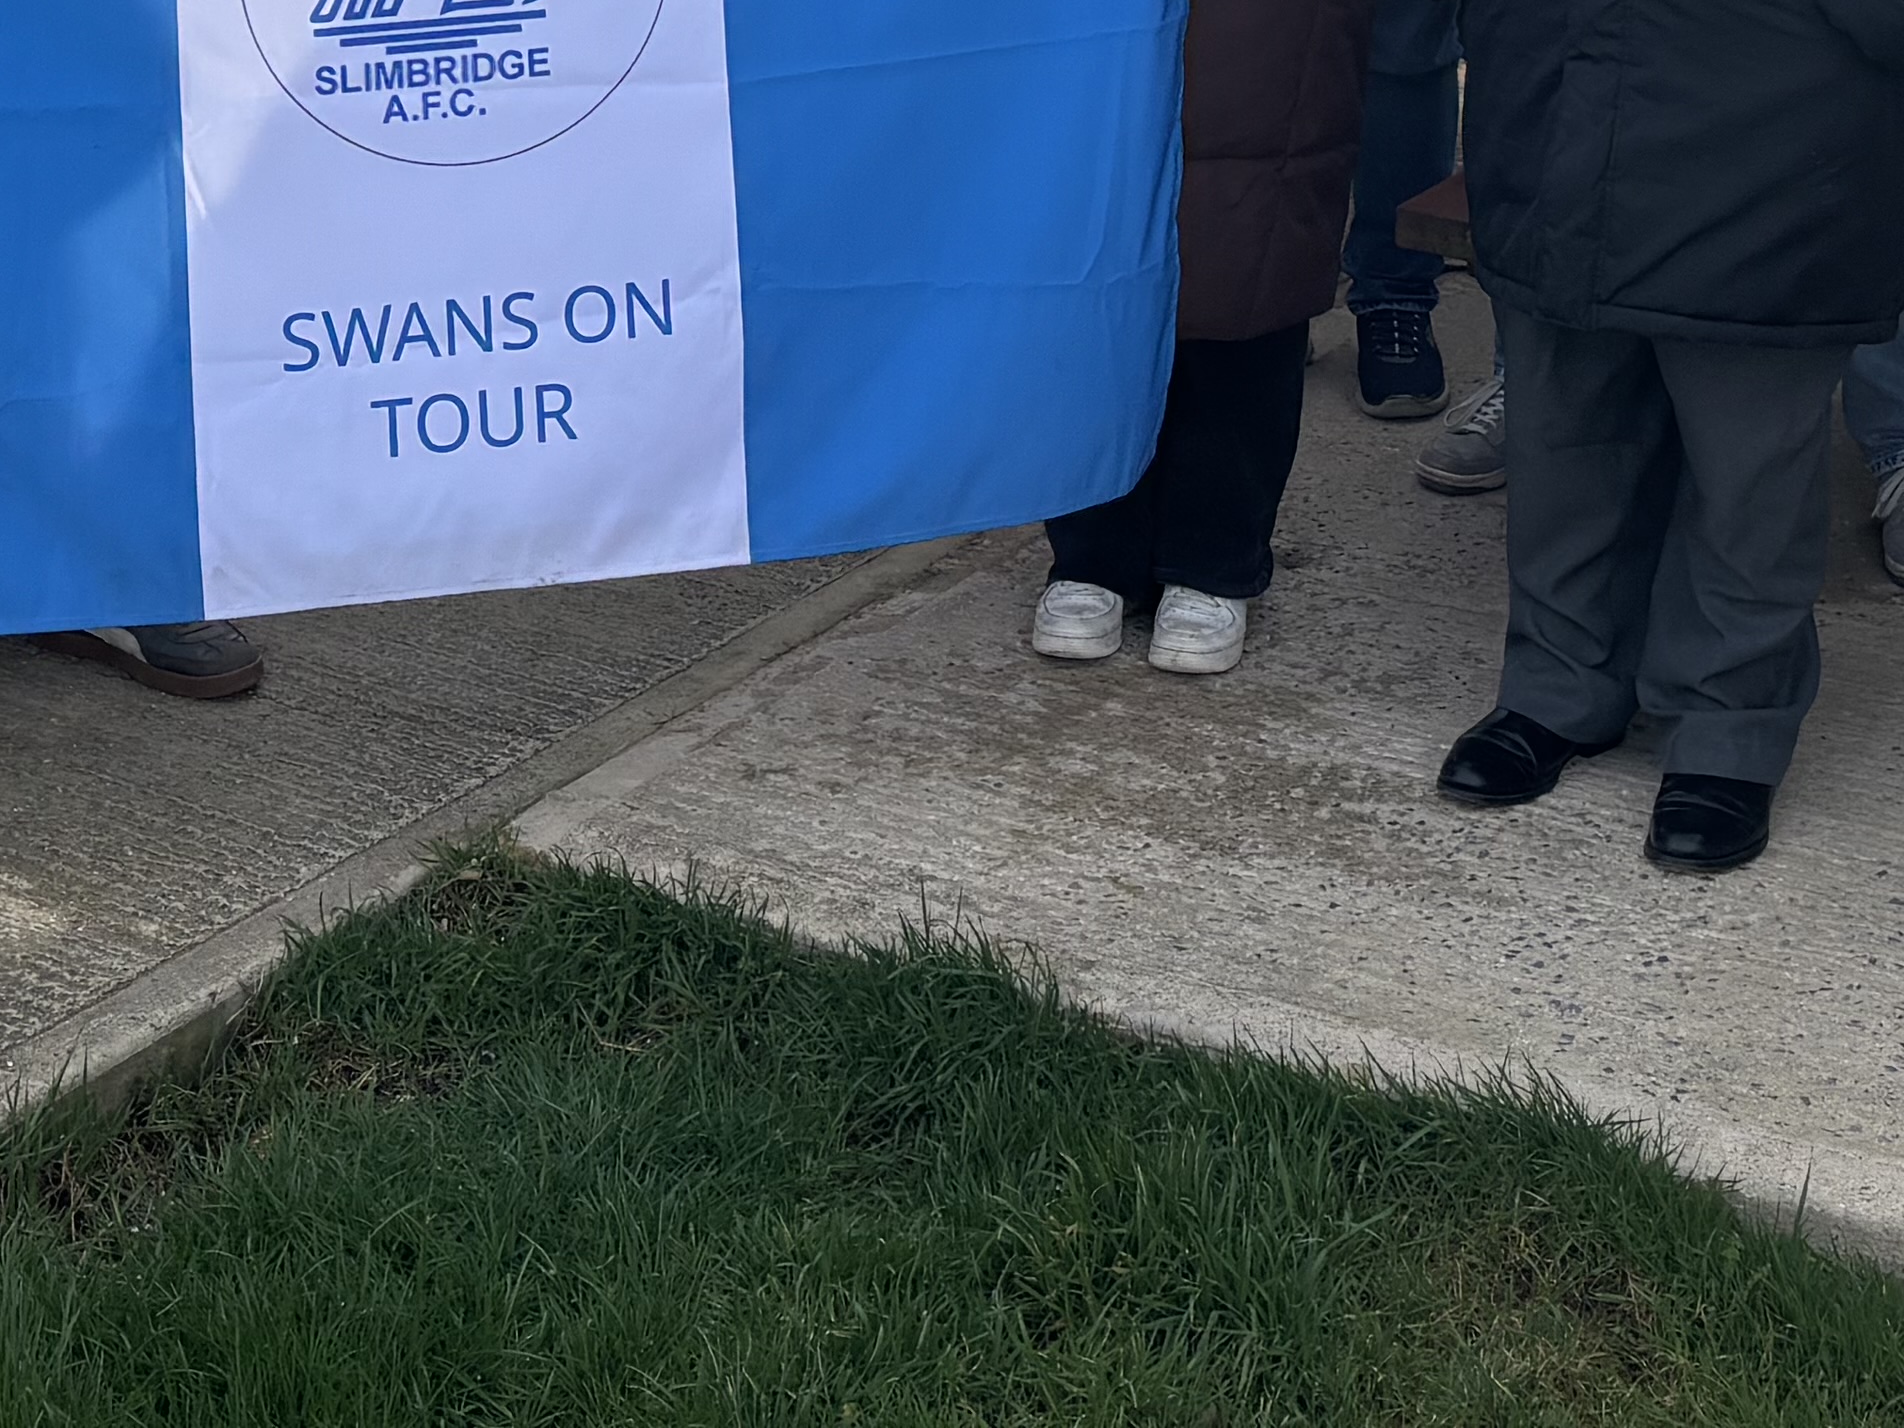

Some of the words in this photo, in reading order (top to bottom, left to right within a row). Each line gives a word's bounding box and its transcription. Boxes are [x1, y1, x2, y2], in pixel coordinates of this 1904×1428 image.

[314, 47, 551, 96] SLIMBRIDGE
[382, 89, 487, 125] A.F.C.
[281, 291, 539, 374] SWANS
[563, 278, 673, 344] ON
[369, 382, 579, 459] TOUR
